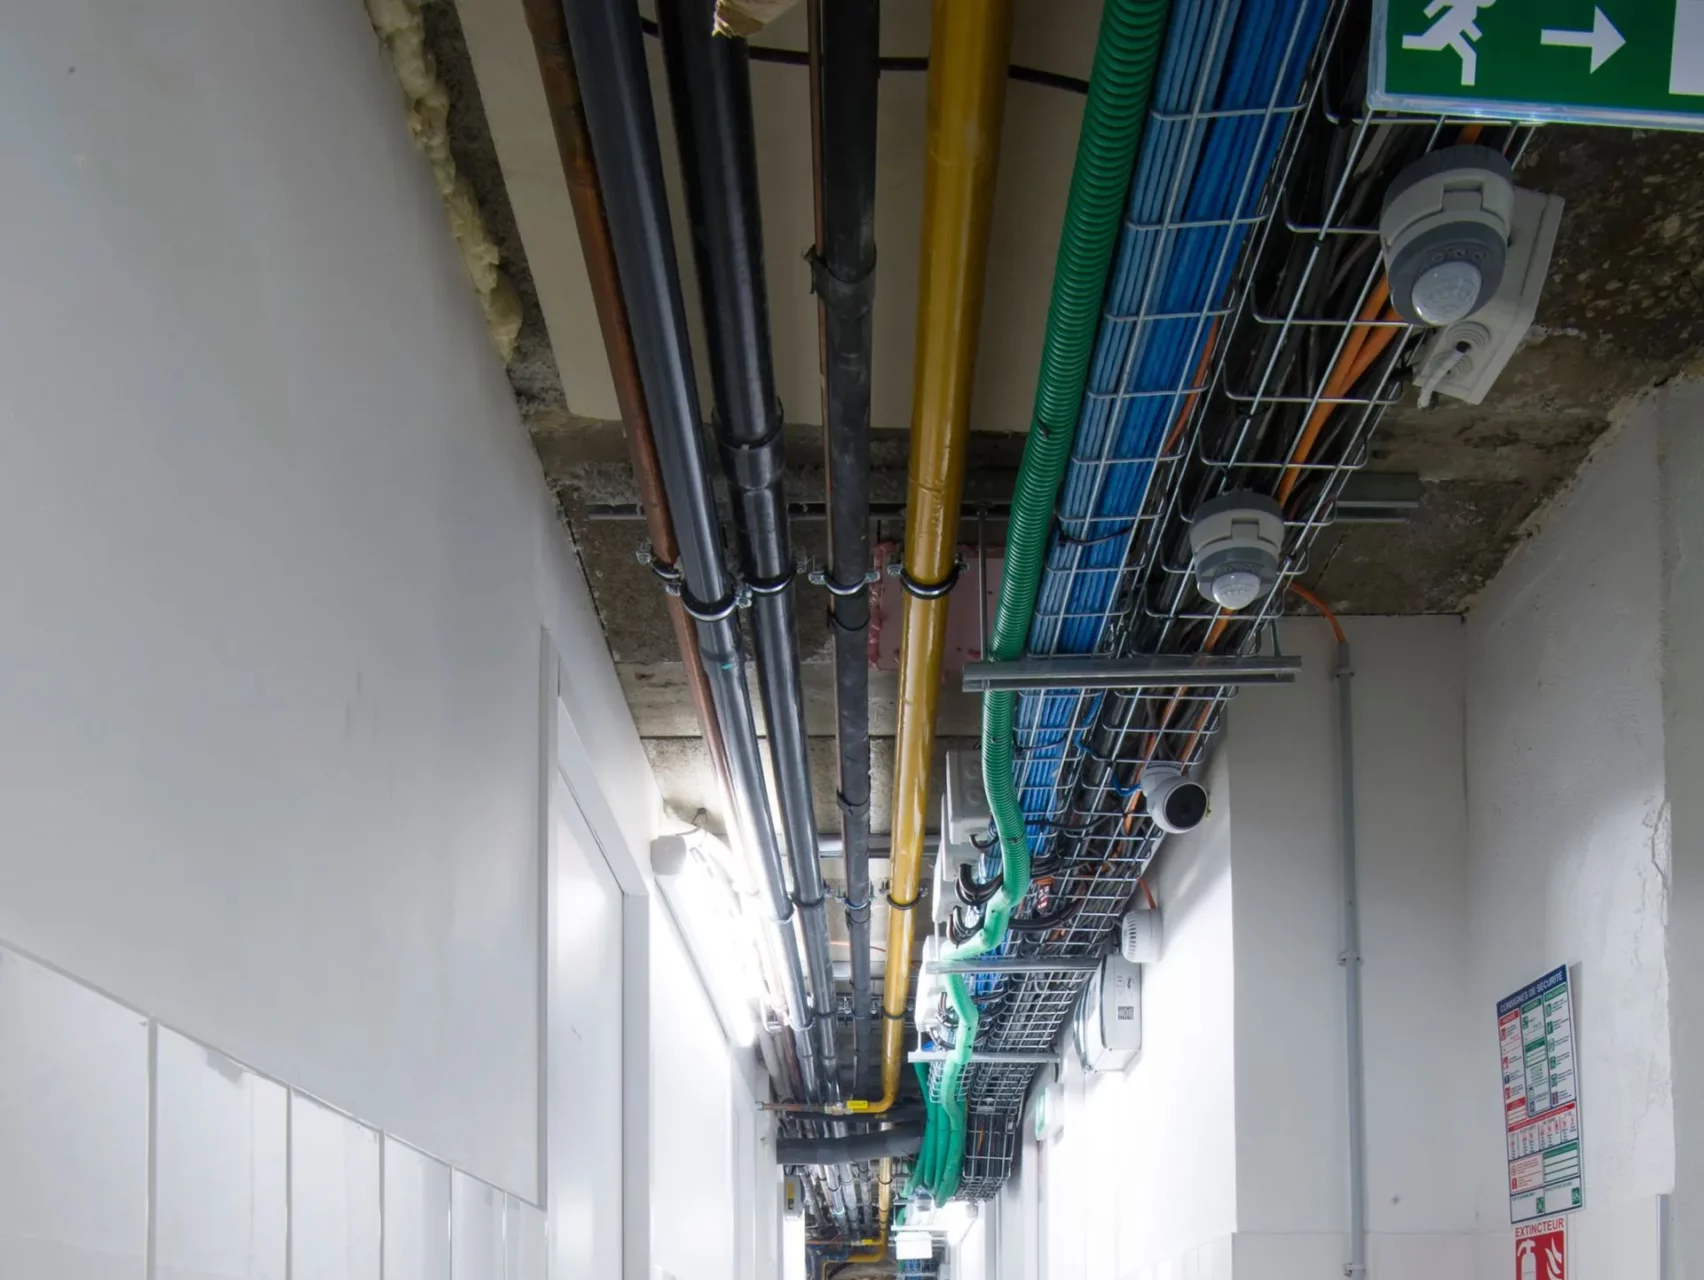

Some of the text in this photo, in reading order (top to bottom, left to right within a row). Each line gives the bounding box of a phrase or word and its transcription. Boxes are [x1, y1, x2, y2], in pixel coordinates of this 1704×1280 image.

[1500, 990, 1529, 1013] CONSIGNES
[1529, 986, 1537, 998] DE
[1515, 1217, 1564, 1237] EXTINCTEUR
